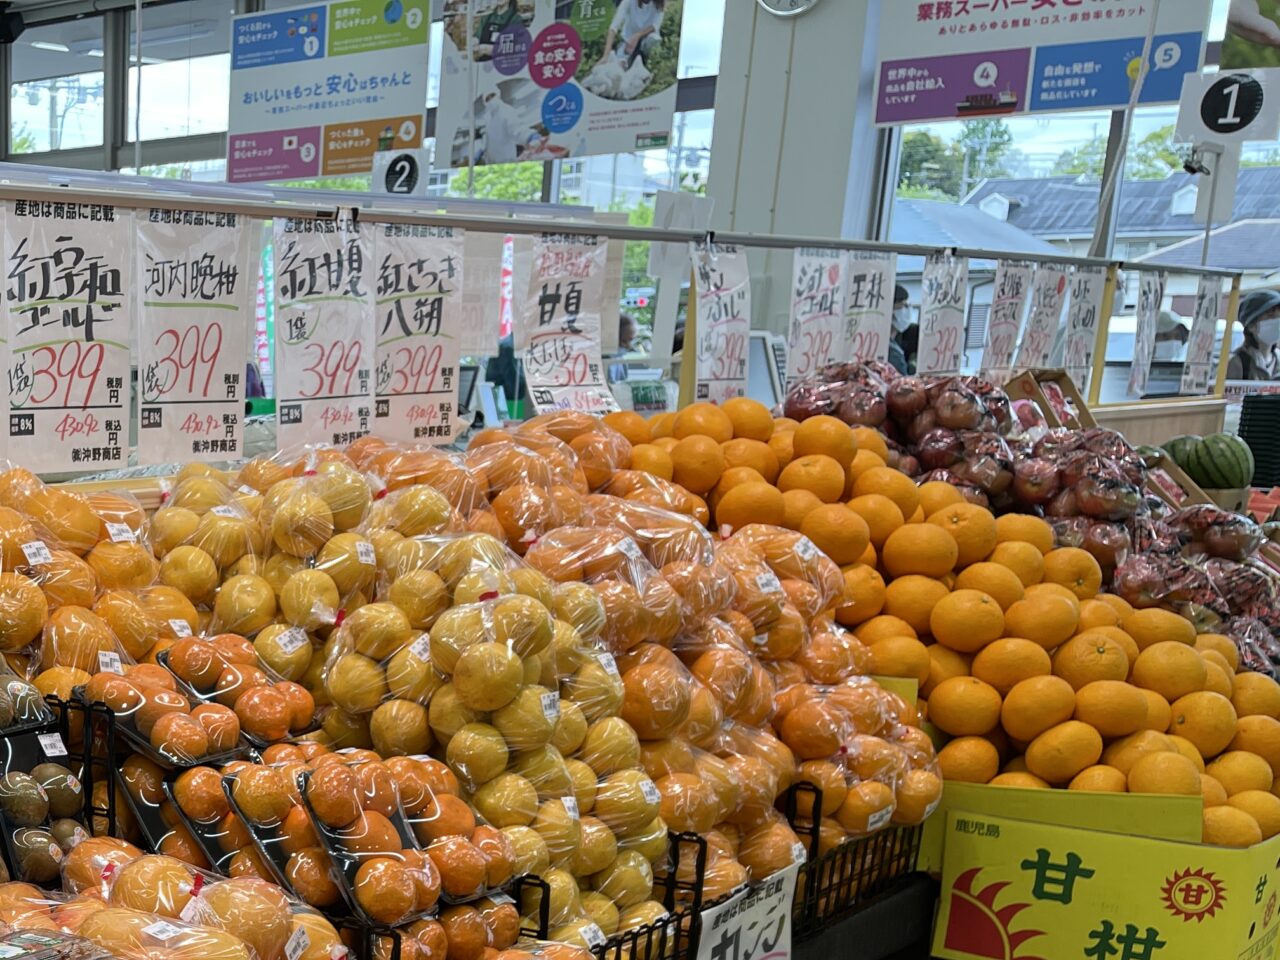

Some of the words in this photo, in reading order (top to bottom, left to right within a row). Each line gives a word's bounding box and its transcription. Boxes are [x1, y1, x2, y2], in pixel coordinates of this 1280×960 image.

[534, 46, 576, 65] 食の安全
[542, 63, 565, 79] 安心
[1216, 83, 1240, 125] 1
[393, 161, 411, 192] 2
[15, 199, 114, 222] 産地は商品に記載
[149, 208, 236, 227] 産地は商品に記載
[7, 236, 124, 304] 紅宇和
[145, 252, 238, 300] 河内晩柑
[376, 253, 457, 296] 紅さつき
[849, 271, 885, 309] 王林
[539, 281, 584, 334] 甘夏
[706, 291, 745, 323] ふじ
[16, 303, 121, 342] ゴールド
[381, 298, 442, 337] 八朔
[155, 323, 221, 397] 399
[300, 341, 361, 397] 399
[30, 340, 104, 411] 399
[224, 374, 239, 384] 税別
[392, 346, 442, 394] 399
[441, 367, 453, 378] 税別
[107, 377, 122, 388] 税別
[226, 385, 236, 398] 円
[360, 381, 368, 392] 円
[443, 378, 451, 389] 円
[109, 390, 119, 403] 円
[440, 403, 452, 413] 税込
[20, 419, 32, 430] 8%
[105, 420, 121, 432] 税込
[223, 413, 237, 425] 税込
[360, 418, 368, 430] 円
[442, 413, 450, 424] 円
[108, 434, 118, 446] 円
[225, 426, 234, 438] 円
[955, 819, 1000, 839] 鹿児島
[1178, 884, 1210, 905] 甘
